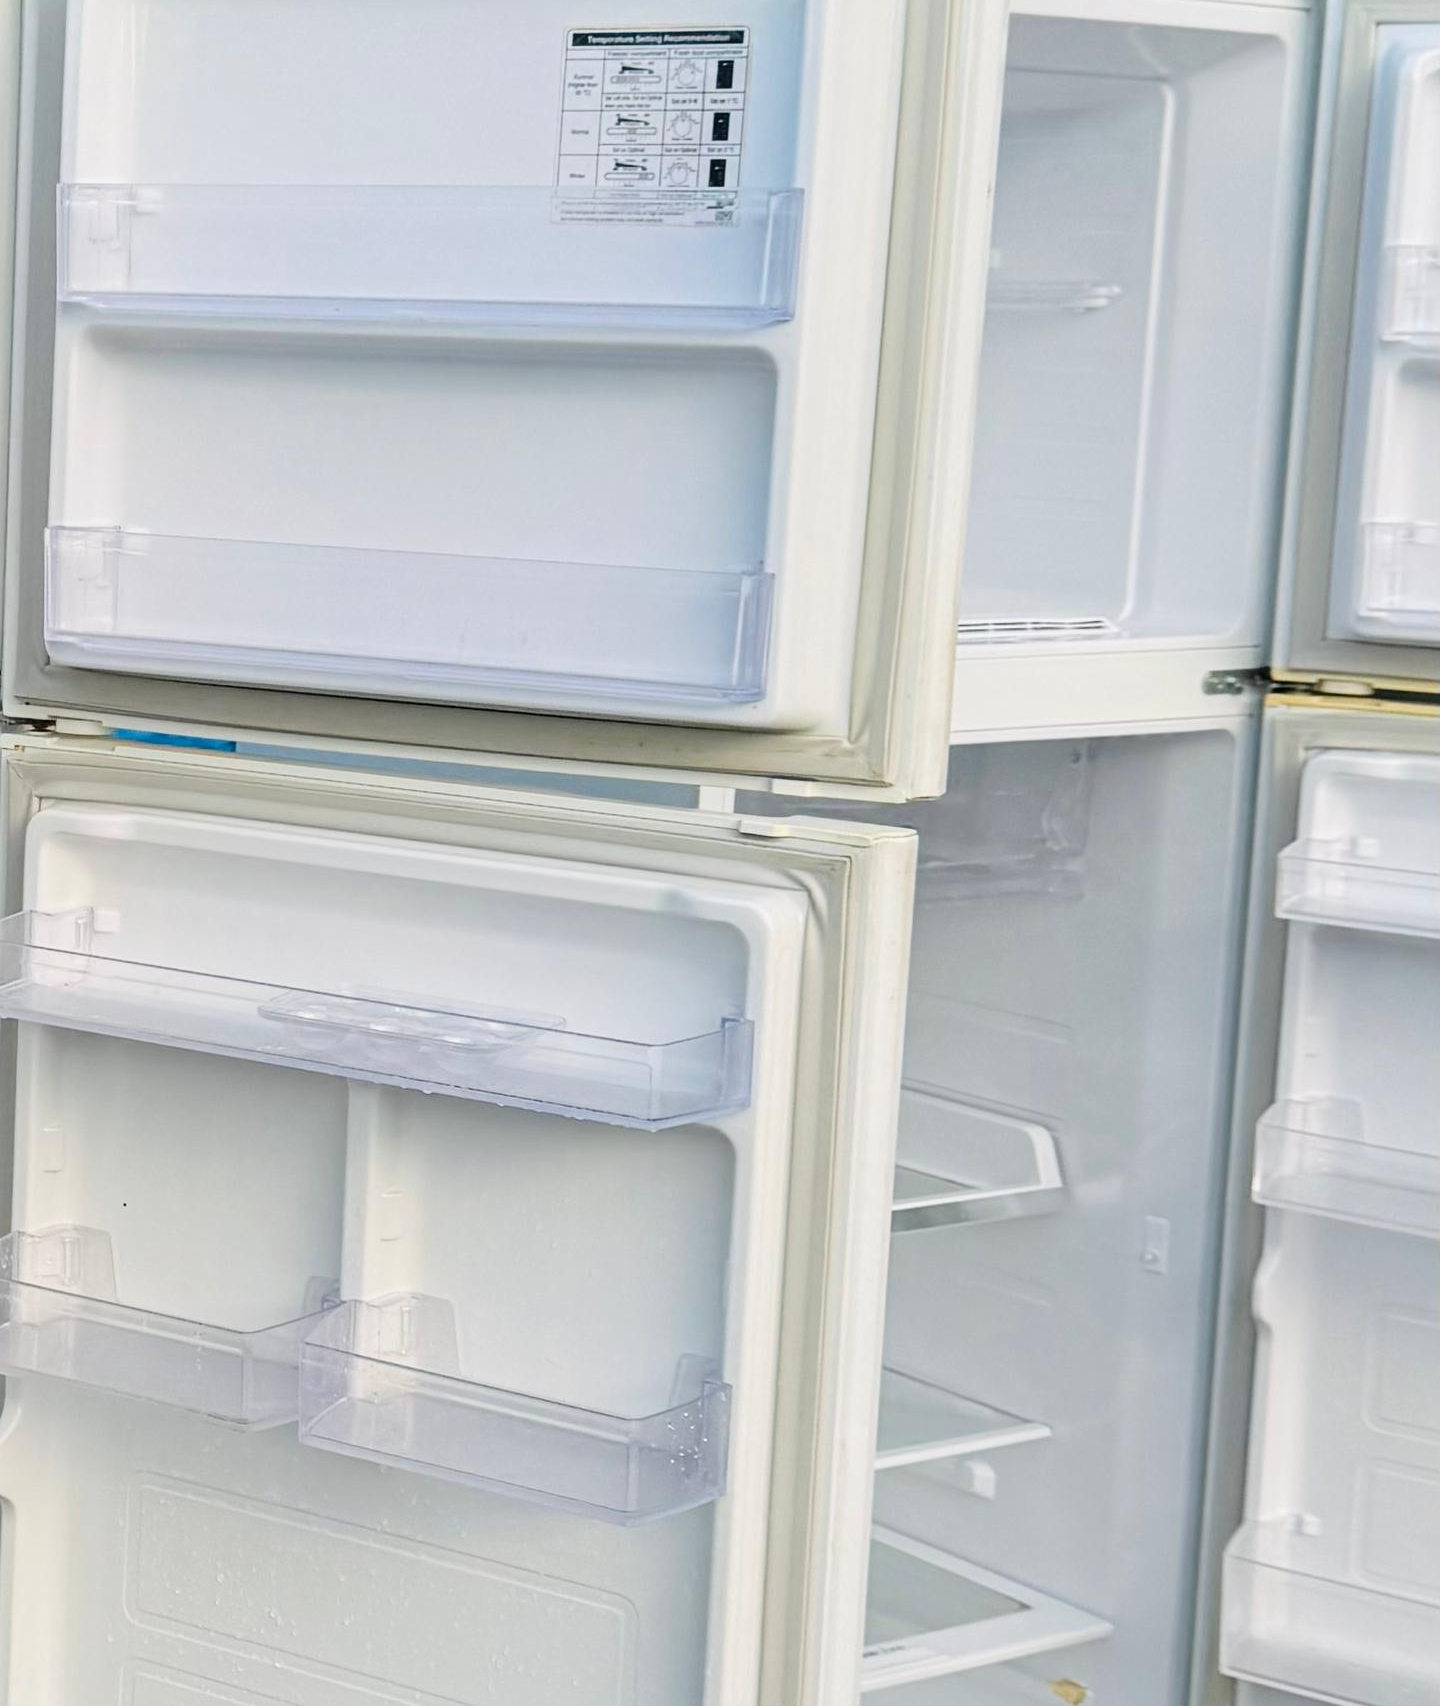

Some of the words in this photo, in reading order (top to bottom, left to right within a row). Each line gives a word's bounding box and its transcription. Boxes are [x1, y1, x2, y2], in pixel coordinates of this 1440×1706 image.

[588, 35, 634, 45] Temperature
[636, 35, 662, 44] Setting
[664, 34, 730, 43] Recommendation
